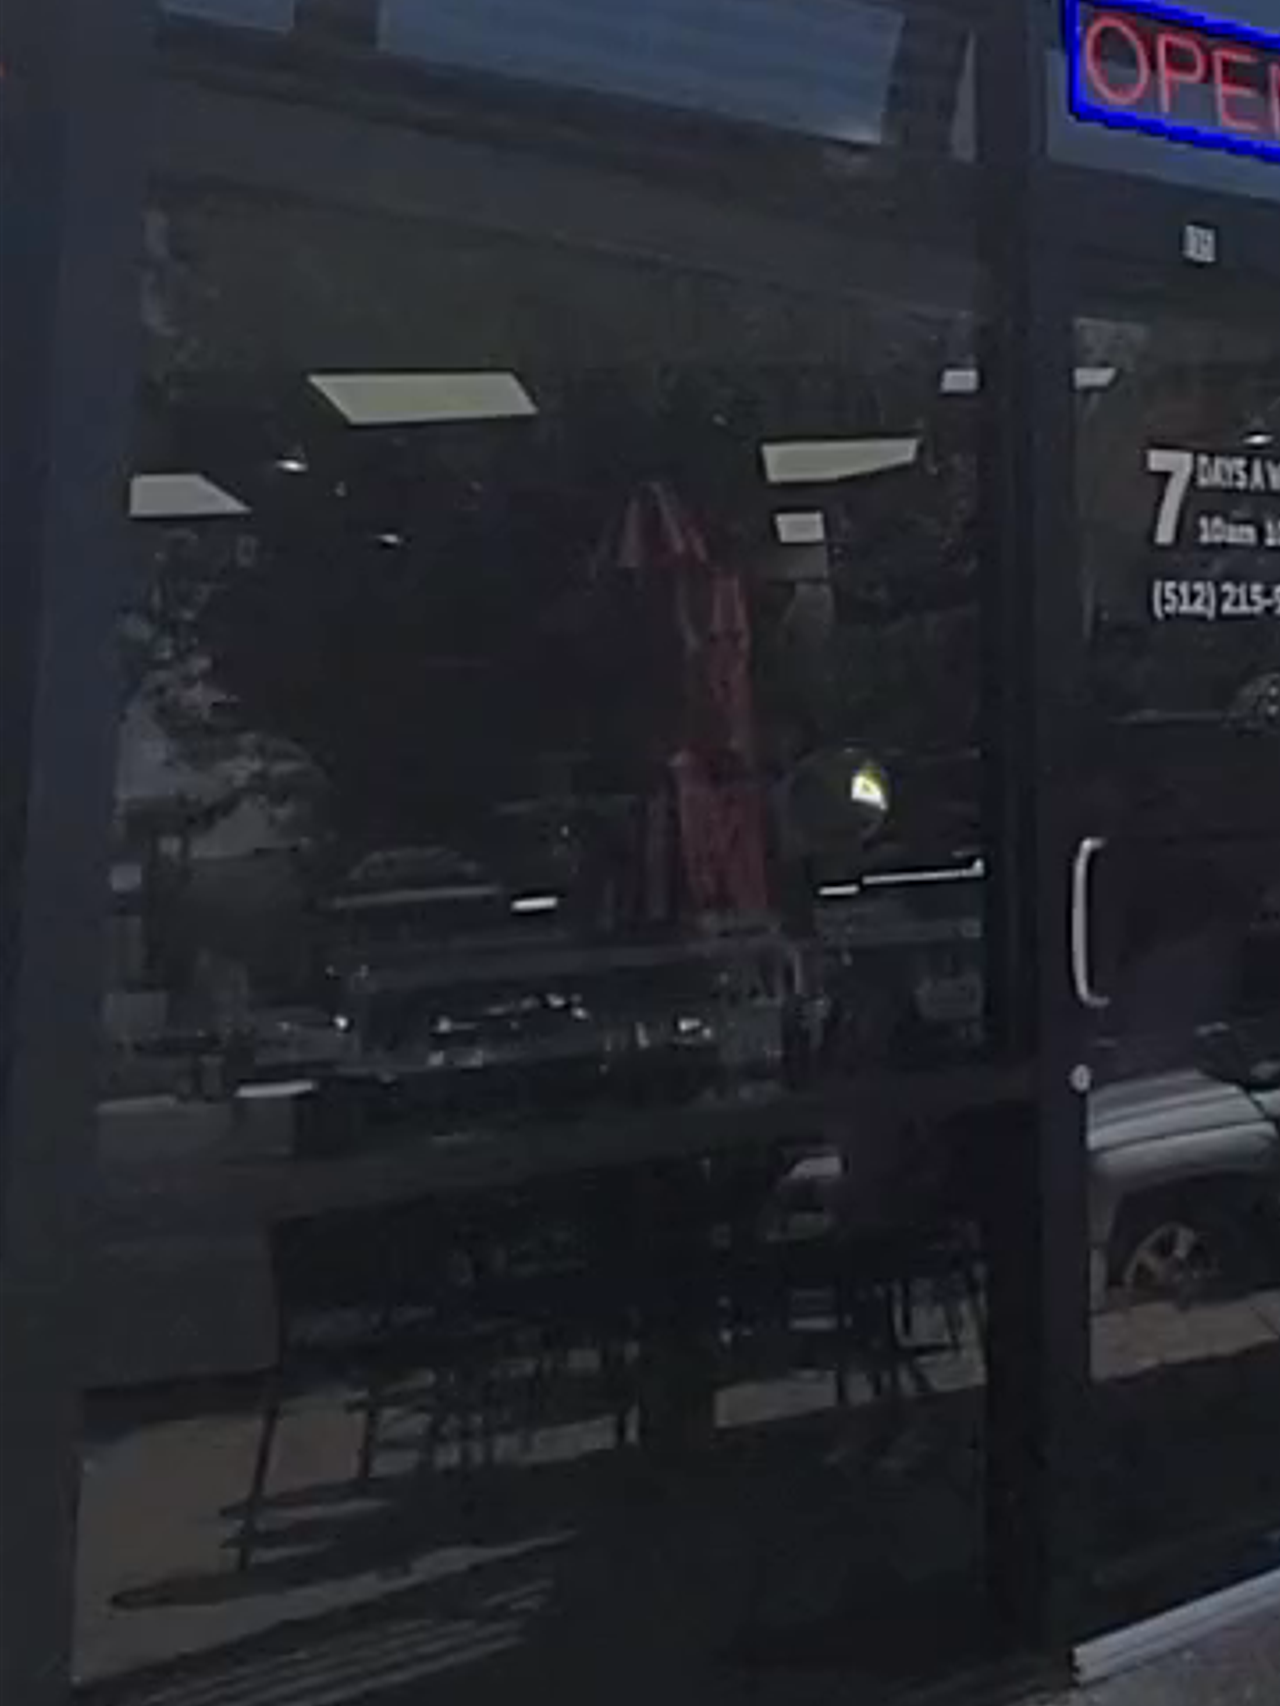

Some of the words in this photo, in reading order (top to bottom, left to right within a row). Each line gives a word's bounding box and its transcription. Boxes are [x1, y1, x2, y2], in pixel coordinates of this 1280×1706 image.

[1147, 449, 1193, 545] 7
[1197, 454, 1249, 490] DAYS
[1250, 459, 1265, 490] A
[1153, 580, 1216, 620] (512)
